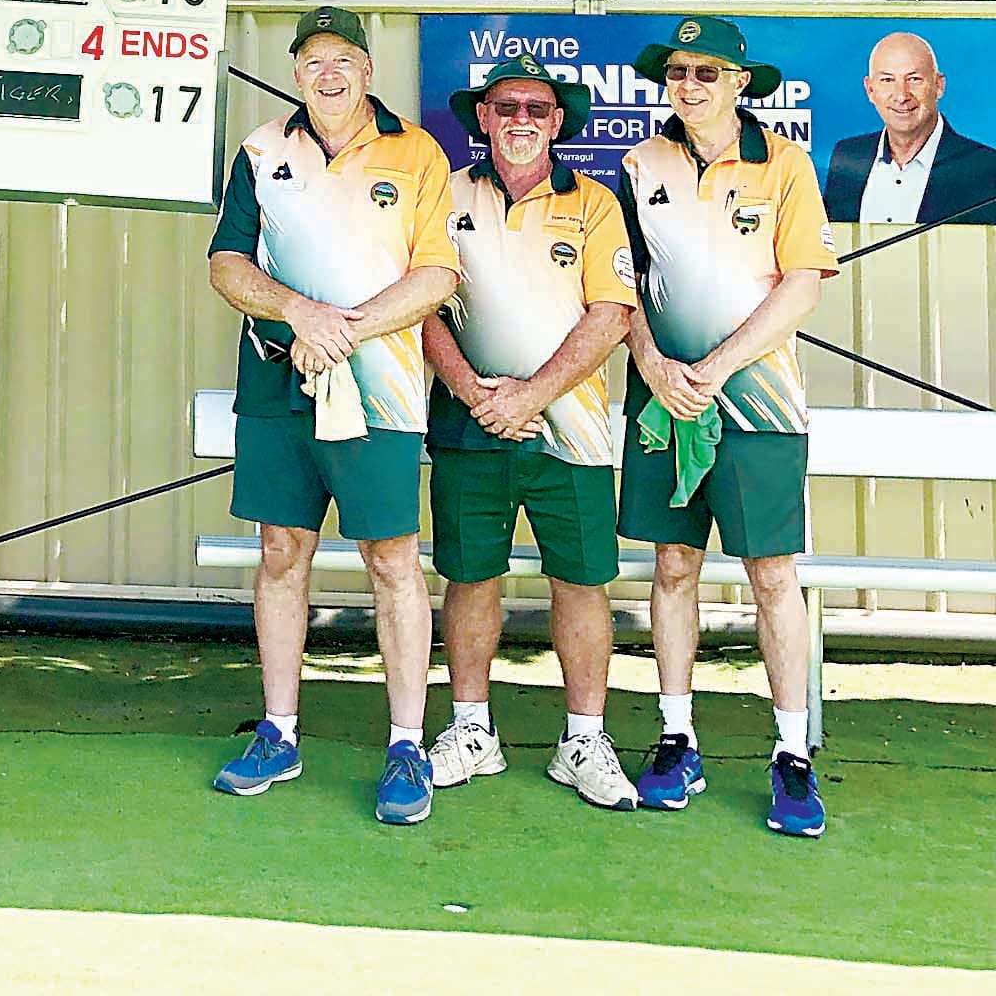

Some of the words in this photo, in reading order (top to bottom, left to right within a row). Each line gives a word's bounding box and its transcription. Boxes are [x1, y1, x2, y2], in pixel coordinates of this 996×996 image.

[81, 25, 104, 60] 4
[122, 30, 209, 60] ENDS
[469, 30, 580, 59] Wayne
[152, 85, 202, 122] 17
[594, 118, 645, 139] FOR
[570, 750, 587, 767] N
